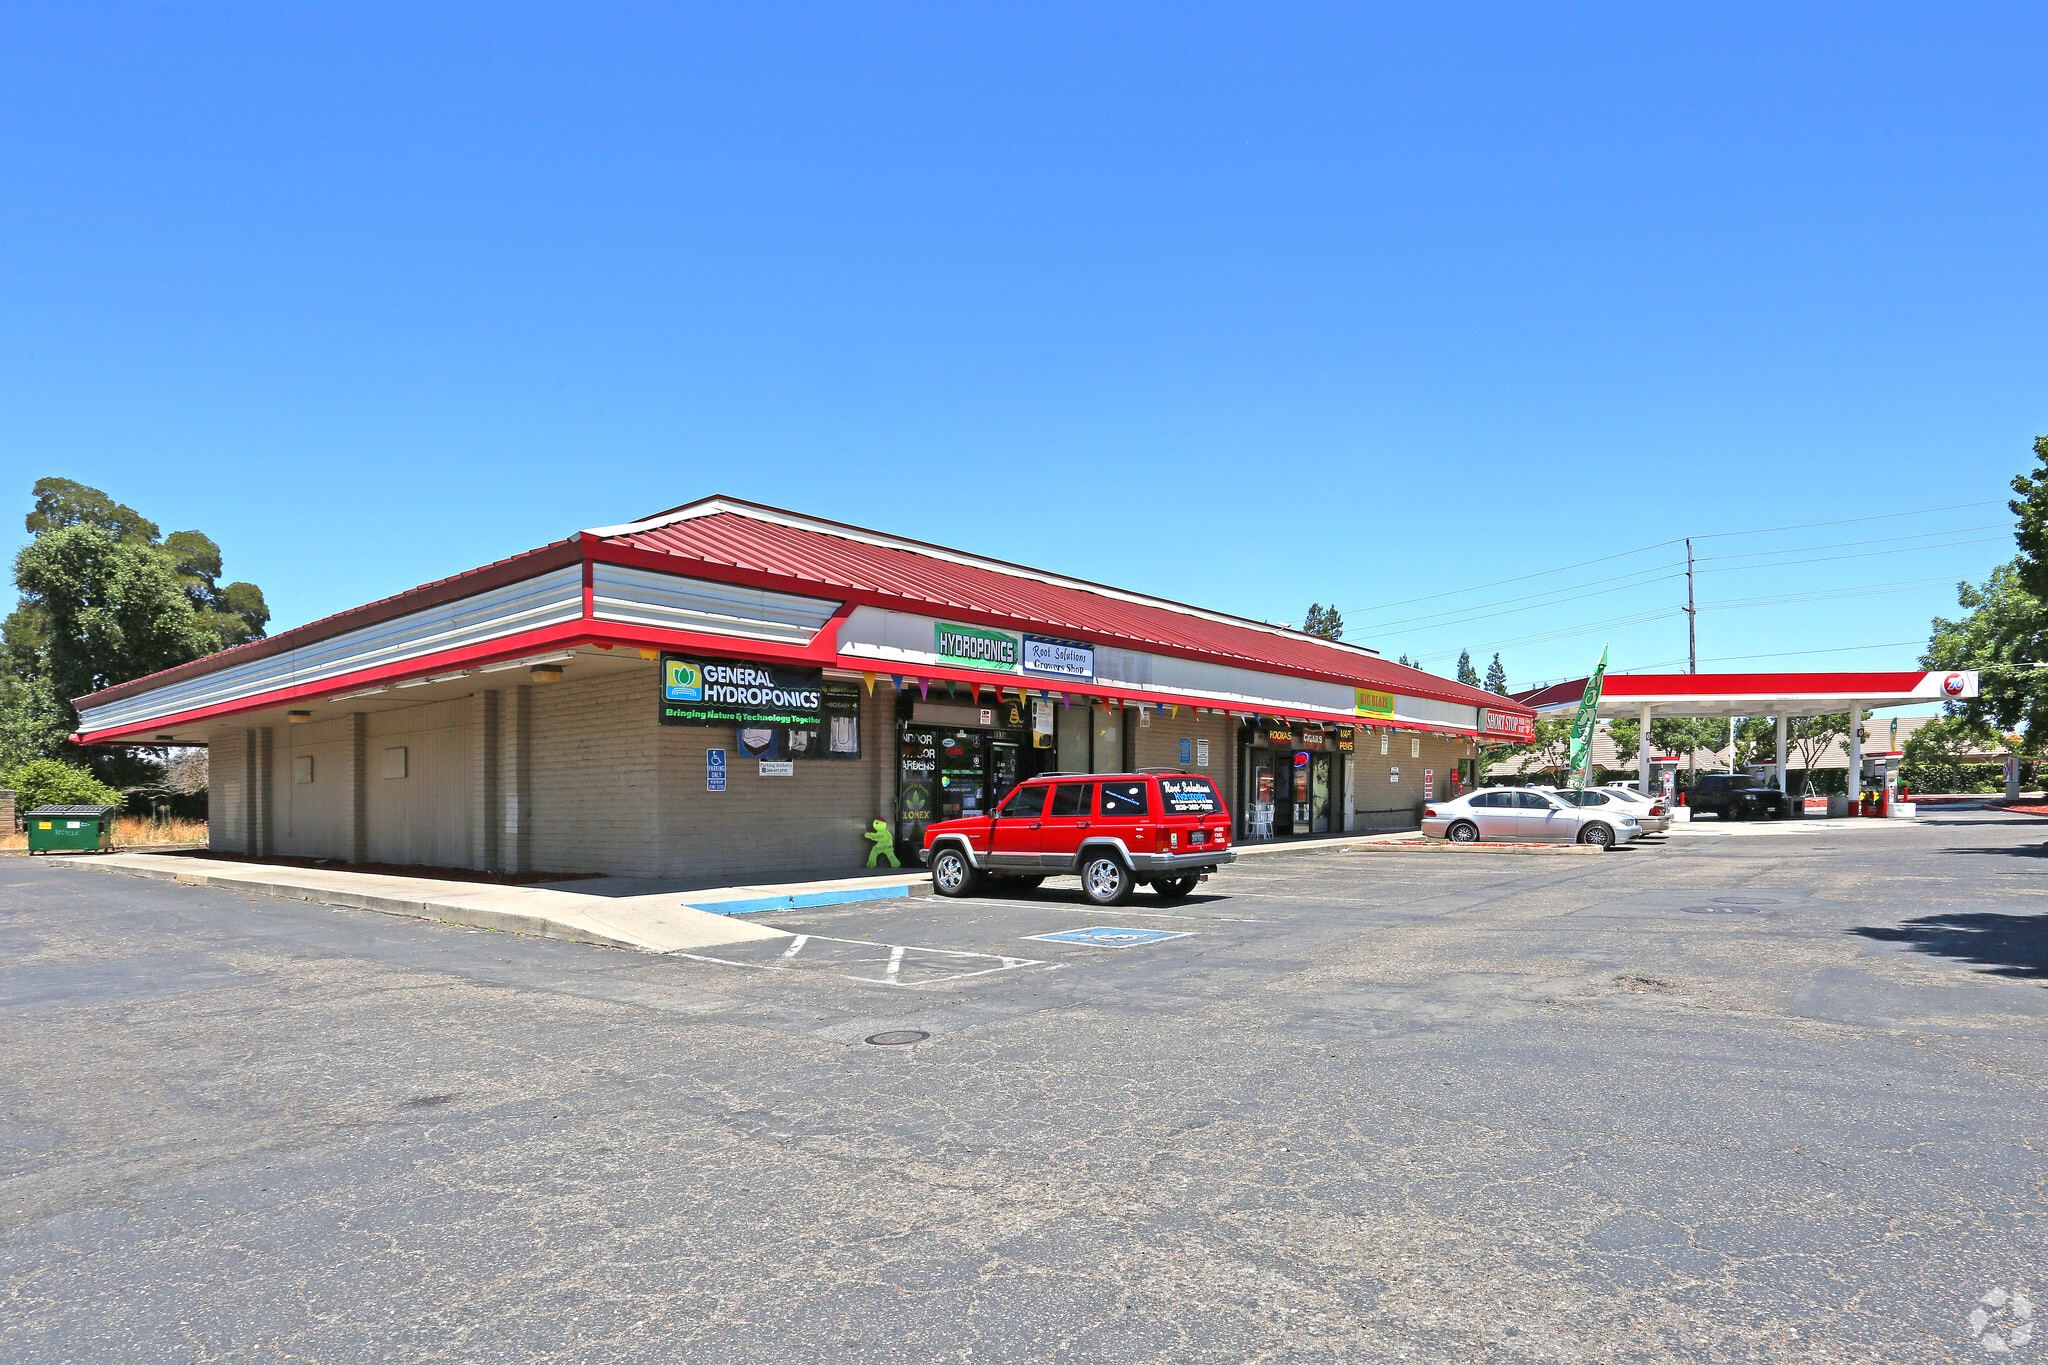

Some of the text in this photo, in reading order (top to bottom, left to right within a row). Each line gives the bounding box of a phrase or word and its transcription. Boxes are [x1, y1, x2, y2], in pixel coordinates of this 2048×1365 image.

[940, 632, 1014, 663] HYDROPONICS
[1032, 645, 1086, 663] Root Solutions
[1034, 659, 1084, 675] Growers Shop
[703, 665, 775, 688] GENERAL
[1947, 677, 1963, 690] 76
[704, 684, 819, 708] HYDROPONICS
[1361, 693, 1388, 709] BIG BLAZE
[665, 708, 706, 720] Bringing
[707, 709, 735, 720] Nature
[742, 713, 791, 724] Technology
[791, 715, 820, 725] Together
[1486, 713, 1505, 730] SHORT
[1505, 715, 1519, 732] STOP
[1269, 730, 1292, 740] HOOKAS
[1303, 733, 1323, 744] CIGARS
[1339, 741, 1353, 751] PENS
[1162, 781, 1211, 793] Root Solutions
